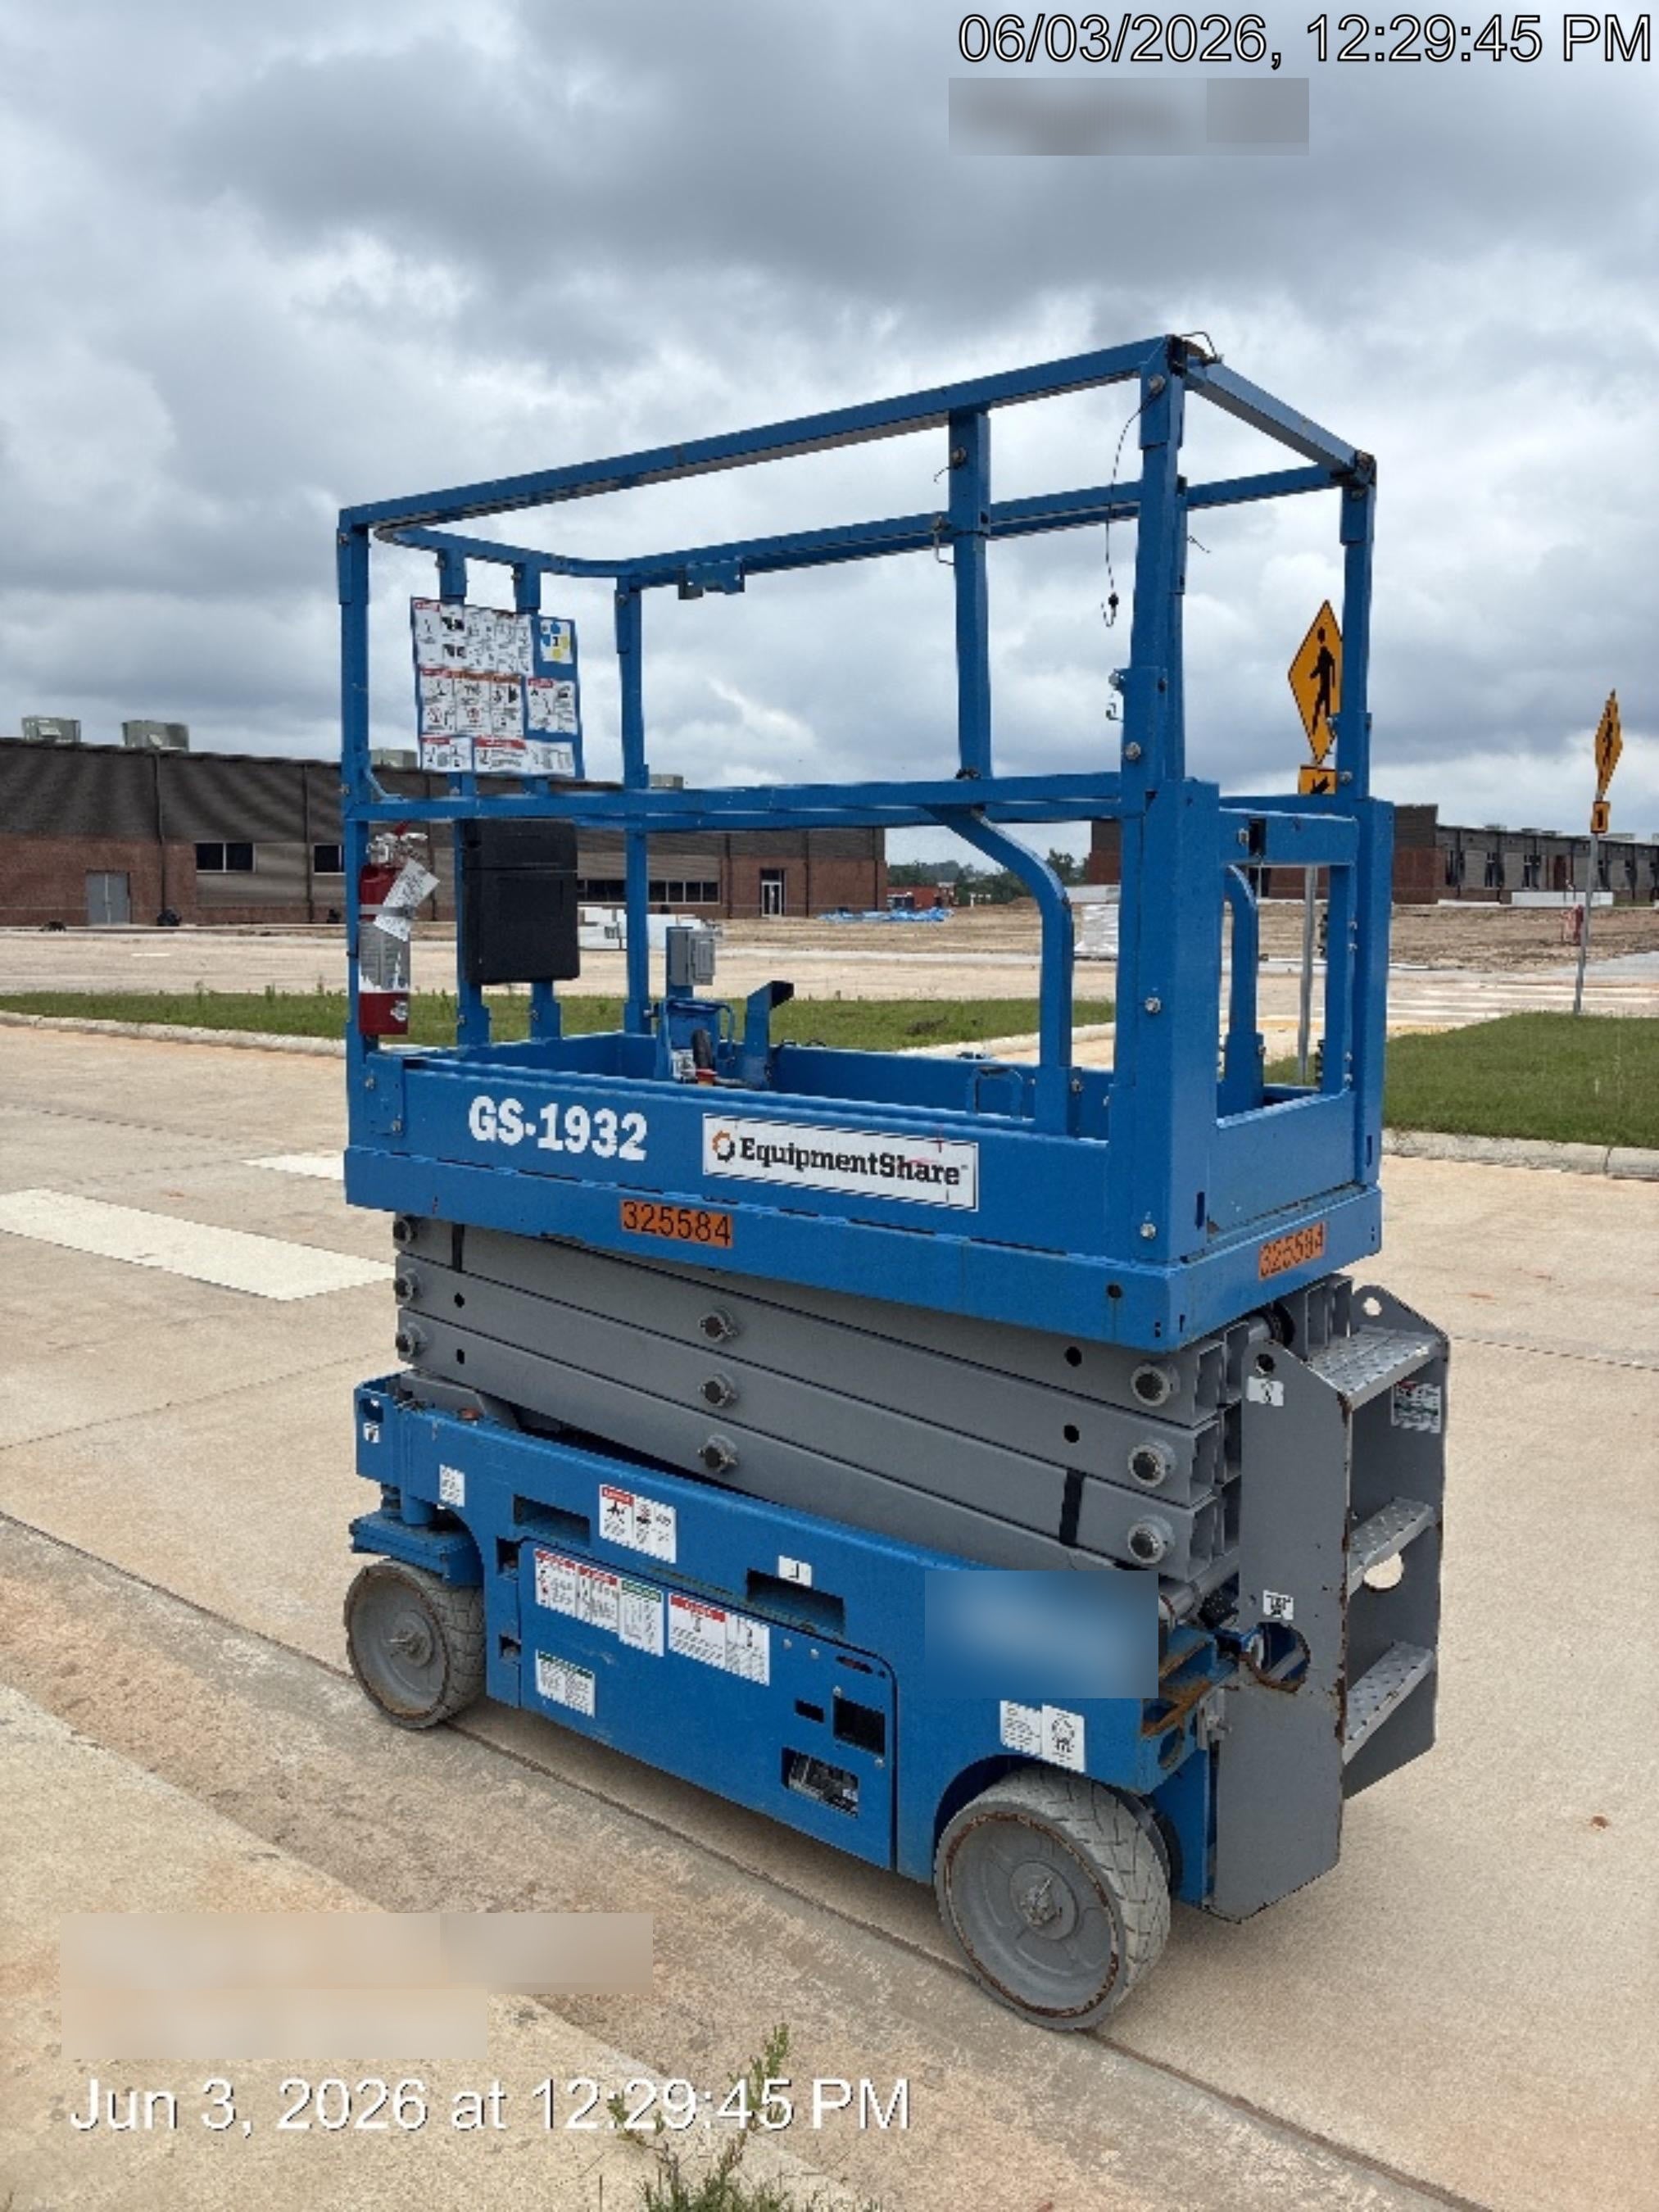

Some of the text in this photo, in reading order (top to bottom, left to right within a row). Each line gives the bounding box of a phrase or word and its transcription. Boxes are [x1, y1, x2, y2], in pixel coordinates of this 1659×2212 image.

[469, 1095, 647, 1161] GS-1932
[740, 1137, 960, 1185] EquipmentShare
[623, 1201, 731, 1247] 325584
